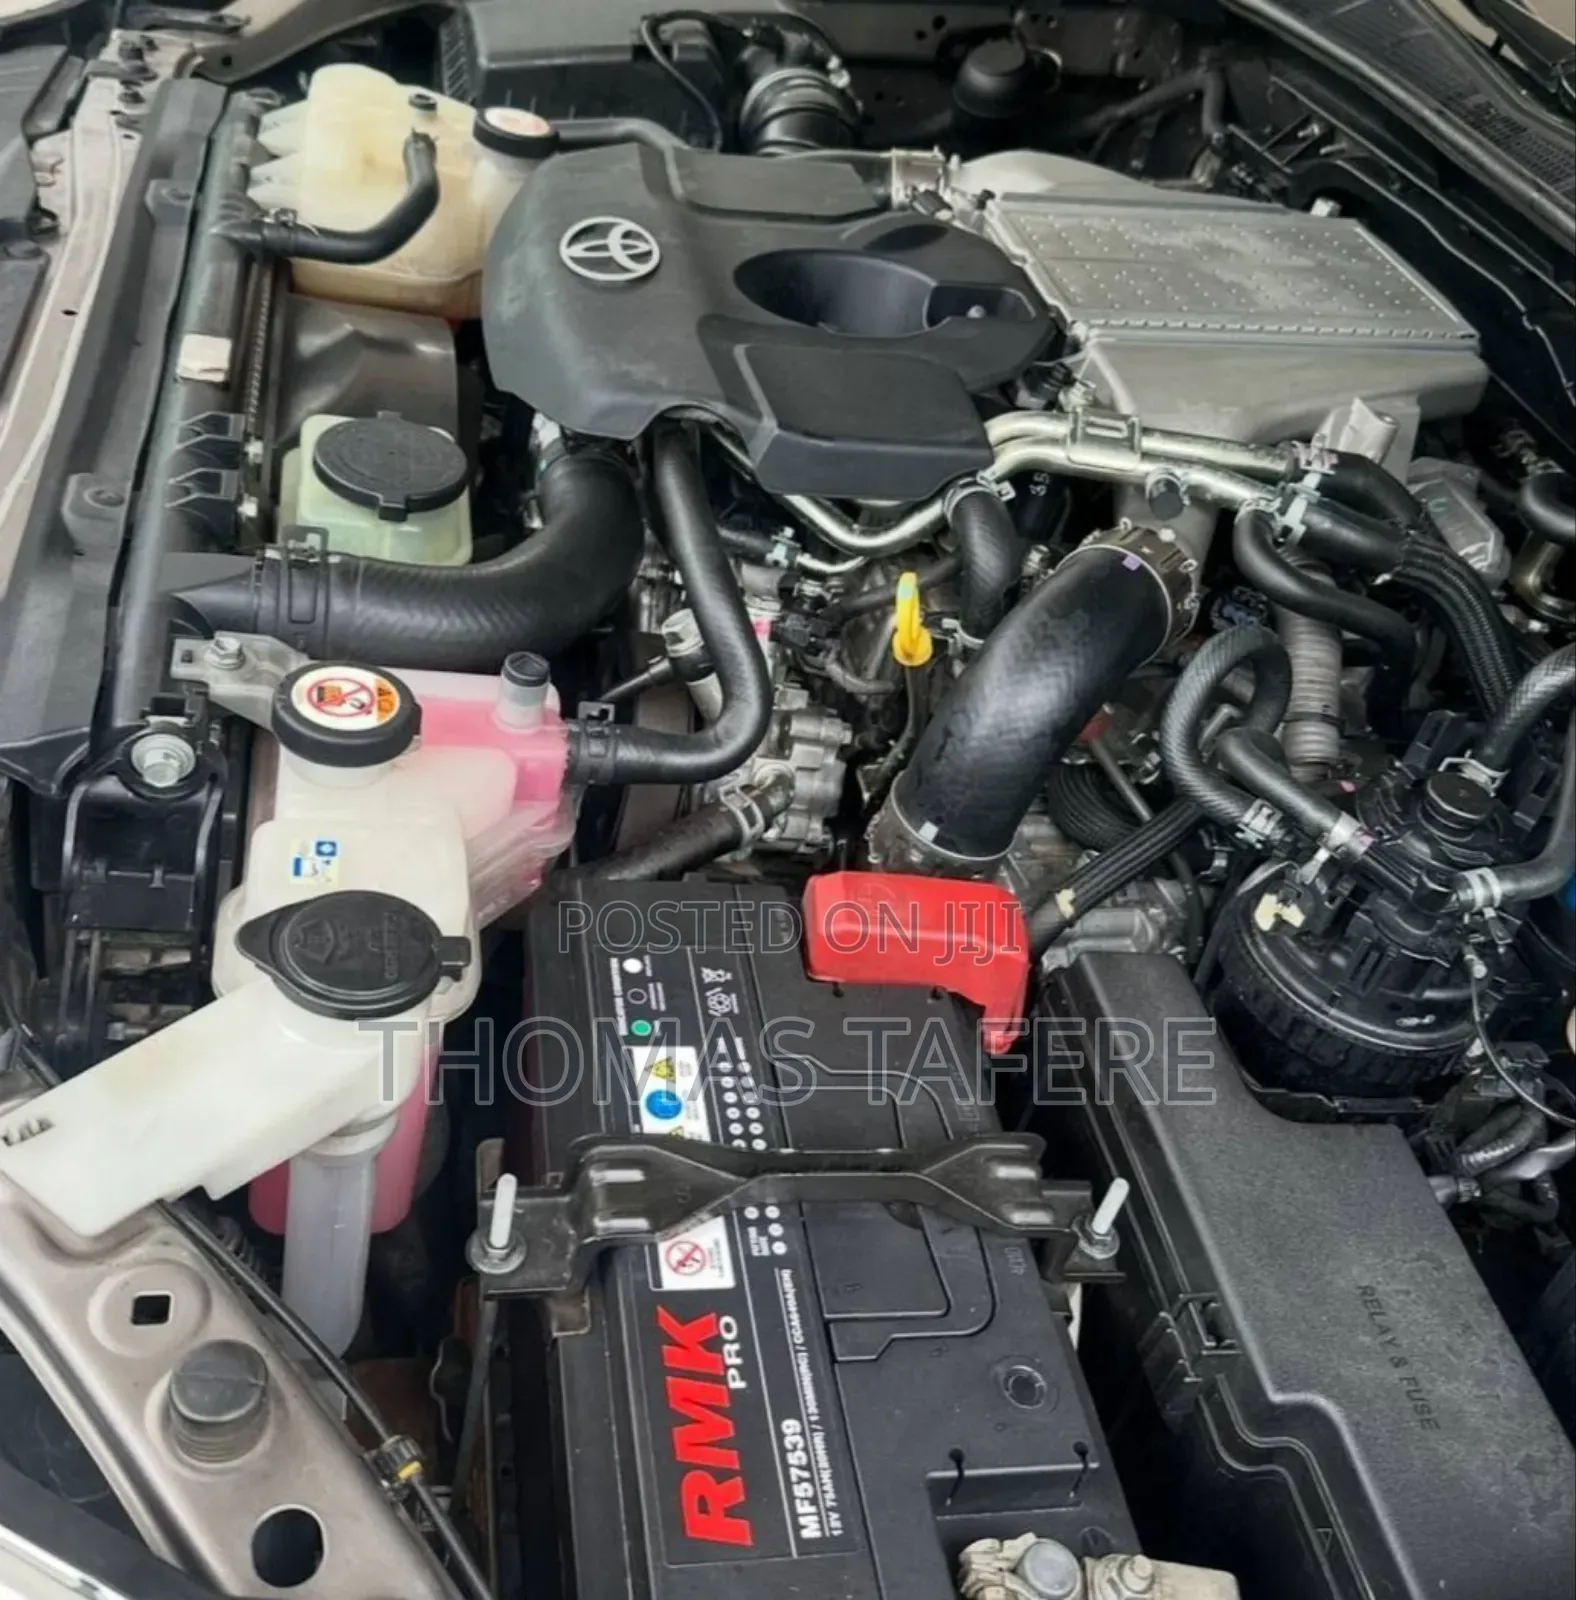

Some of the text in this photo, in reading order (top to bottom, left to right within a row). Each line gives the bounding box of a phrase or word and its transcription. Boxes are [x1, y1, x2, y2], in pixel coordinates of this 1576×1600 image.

[718, 1315, 748, 1389] PRO
[1356, 1284, 1442, 1431] RELAY & FUSE
[656, 1304, 753, 1546] RMK
[780, 1418, 823, 1540] MF57539
